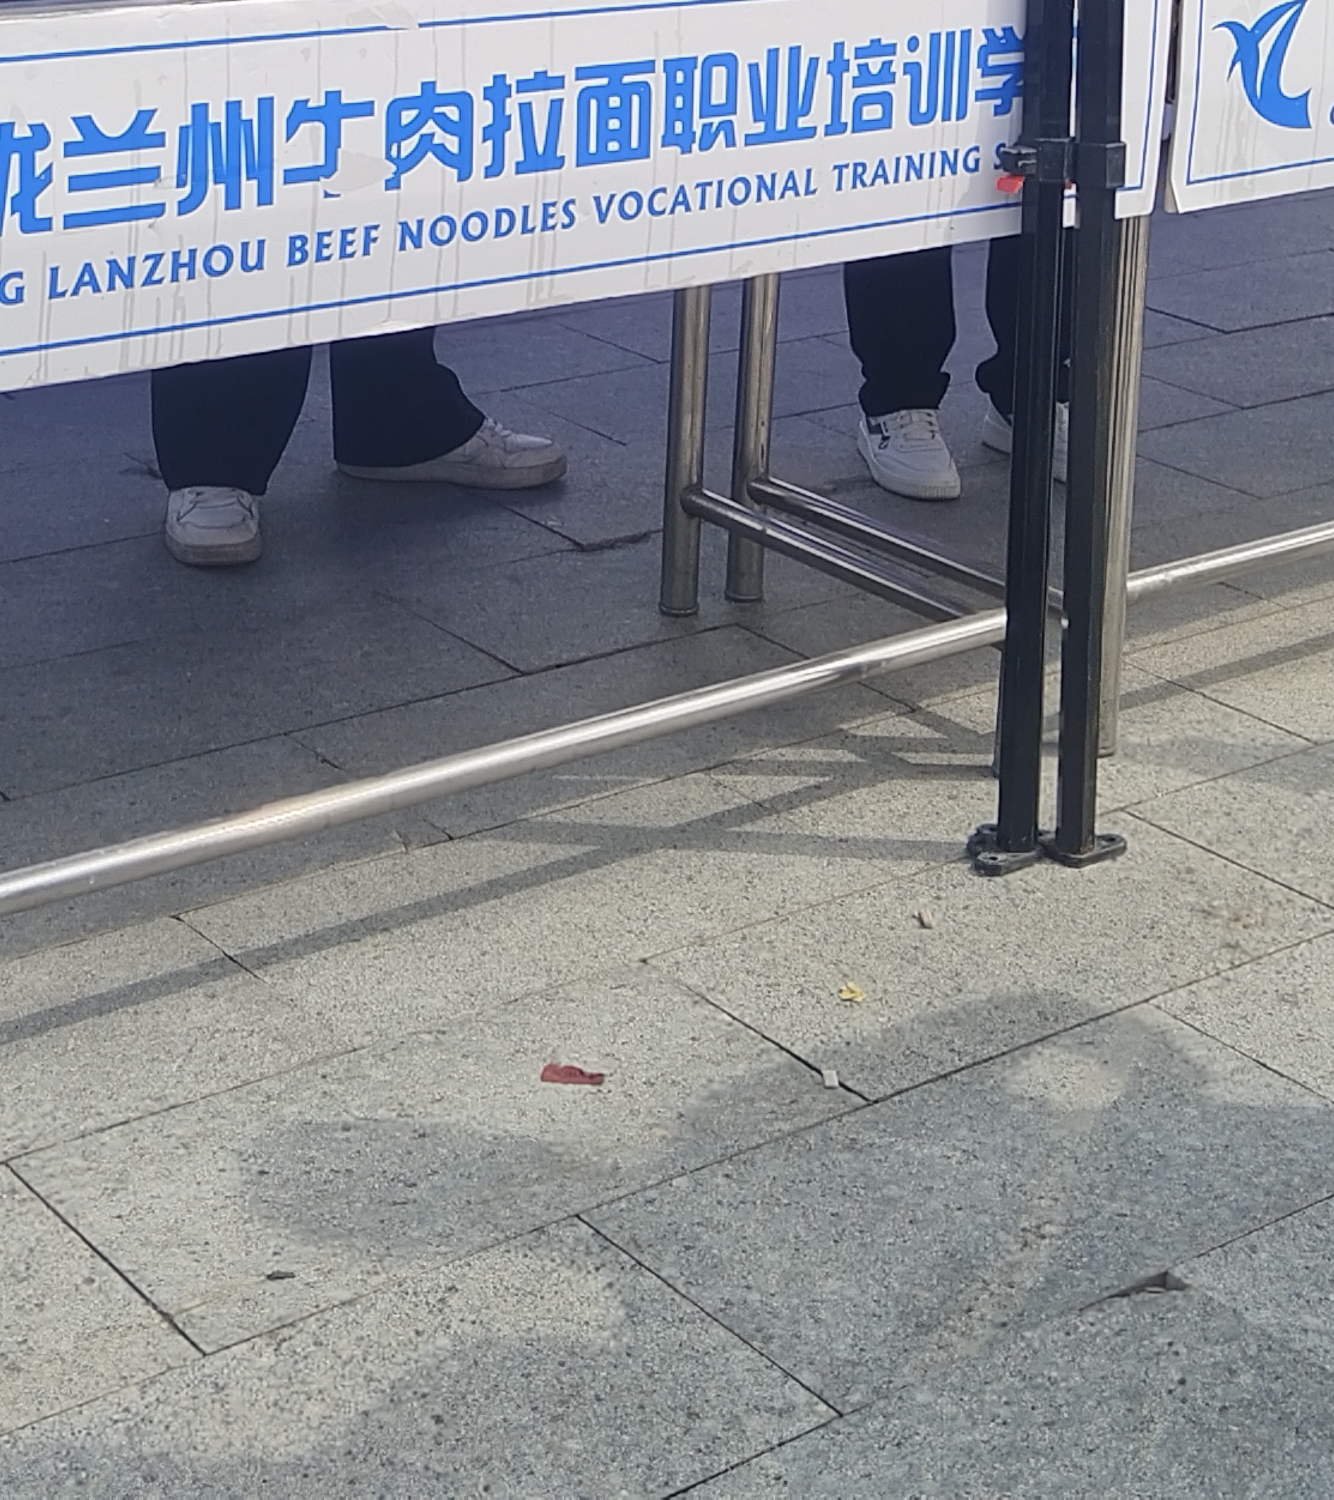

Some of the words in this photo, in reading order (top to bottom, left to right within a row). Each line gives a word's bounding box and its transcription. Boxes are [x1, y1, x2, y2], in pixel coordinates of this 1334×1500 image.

[48, 238, 265, 300] LANZHOU
[287, 224, 379, 267] BEEF
[398, 198, 576, 251] NOODLES
[593, 167, 817, 223] VOCATIONAL
[832, 145, 980, 192] TRAINING
